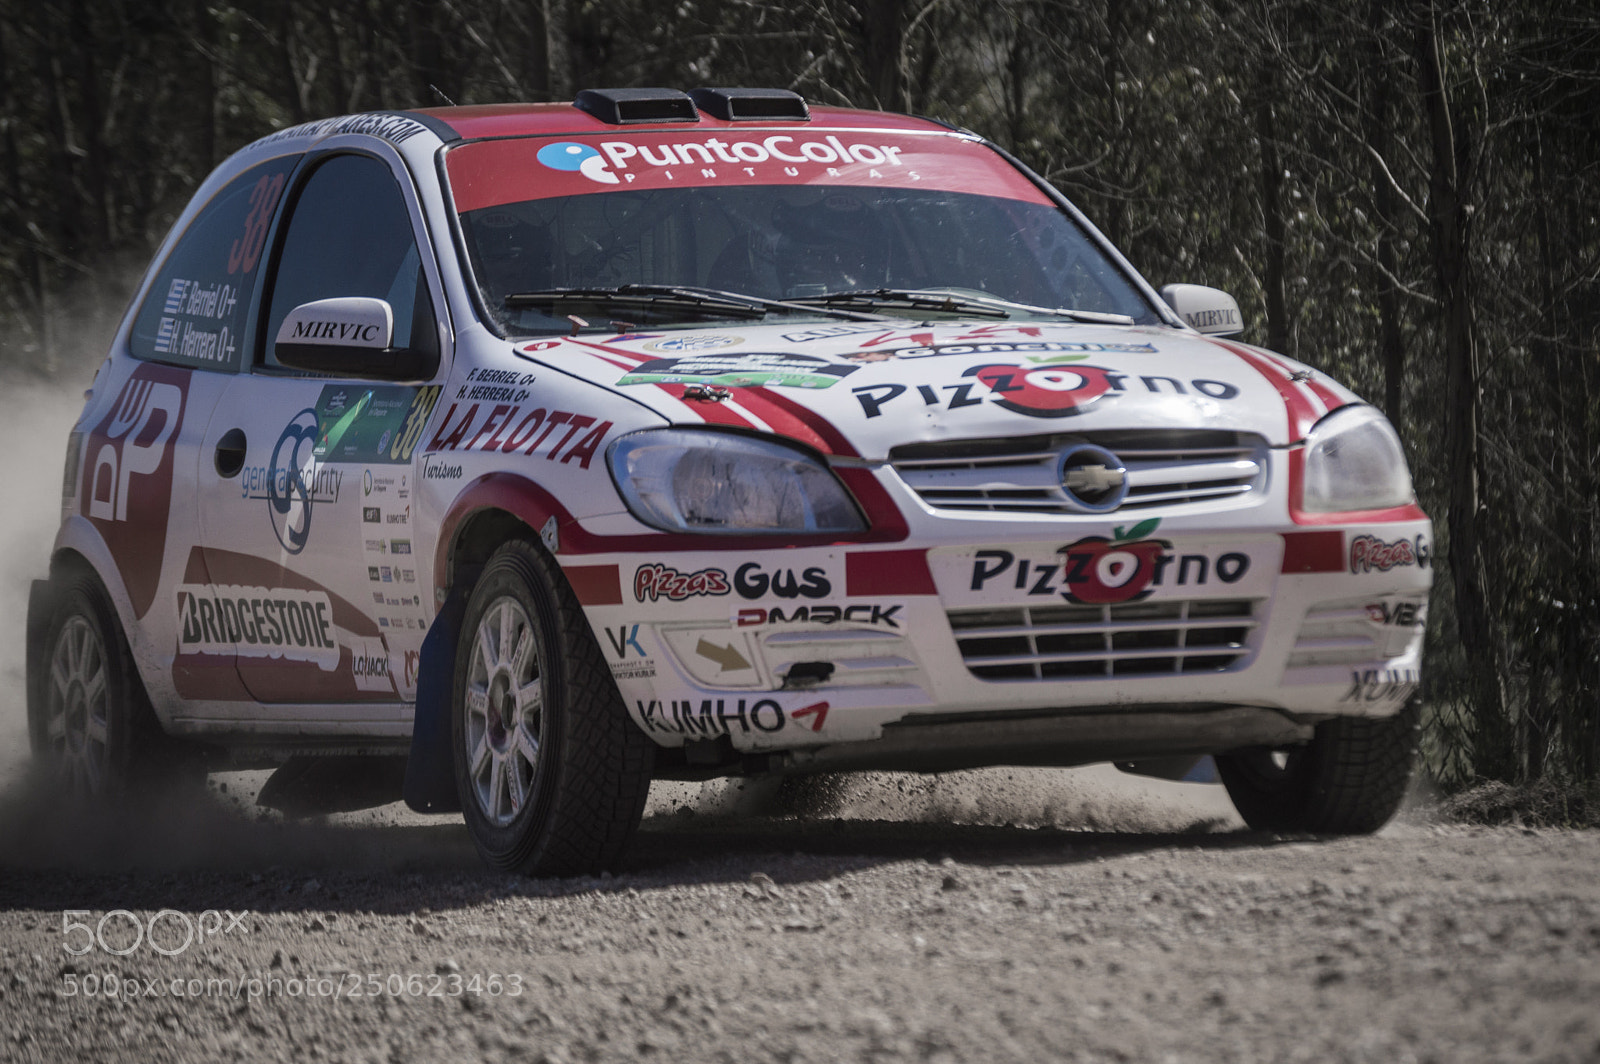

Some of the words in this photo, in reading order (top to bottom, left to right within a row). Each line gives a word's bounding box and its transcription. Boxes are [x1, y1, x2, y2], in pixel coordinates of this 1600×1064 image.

[600, 136, 902, 169] PuntoColor
[624, 166, 921, 183] PINTURAS
[228, 173, 284, 274] 38
[292, 321, 380, 342] MIRVIC
[1186, 309, 1237, 328] MIRVIC
[180, 322, 218, 360] Herrera
[456, 385, 466, 399] H.
[467, 386, 514, 402] HERRERA
[466, 368, 476, 382] F.
[476, 368, 520, 385] BERRIEL
[390, 385, 440, 461] 38
[425, 403, 480, 452] LA
[464, 404, 614, 470] FLOTTA
[422, 453, 463, 479] Turismo
[1351, 534, 1416, 574] Pizzas
[634, 564, 732, 602] Pizzas
[177, 591, 335, 649] BRIDGESTONE
[604, 624, 648, 659] VK
[636, 700, 786, 734] KUMHO
